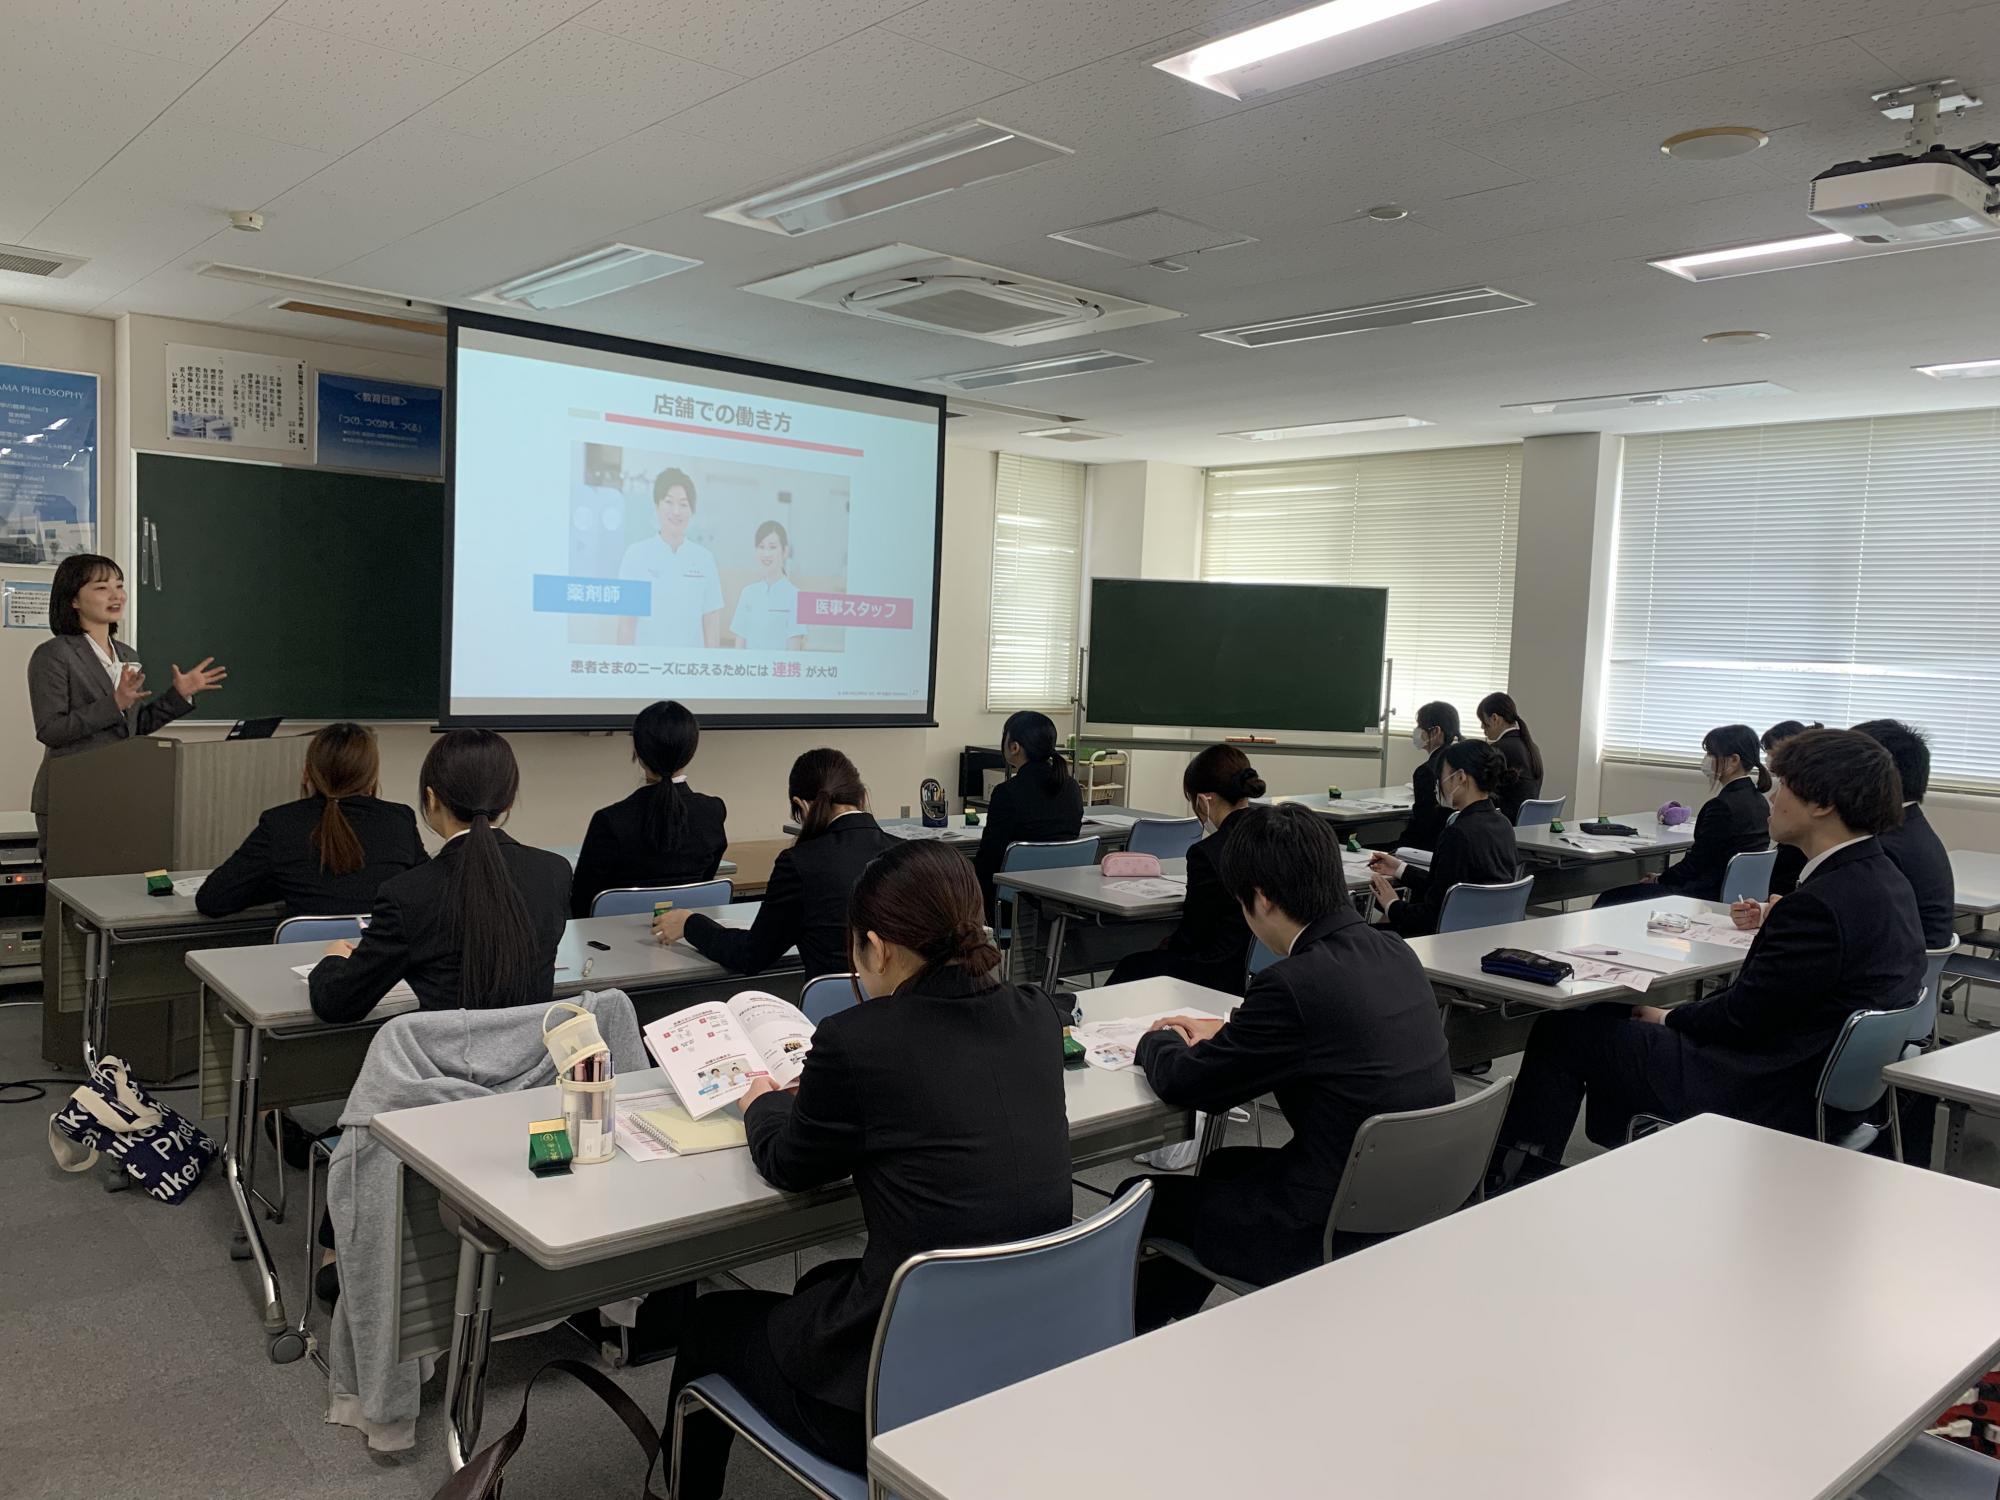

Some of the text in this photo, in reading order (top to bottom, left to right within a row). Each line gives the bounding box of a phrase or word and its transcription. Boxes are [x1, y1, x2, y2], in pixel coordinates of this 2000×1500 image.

[21, 385, 84, 400] PHILOSOPHY
[653, 393, 792, 433] 店舗での働き方
[567, 583, 621, 604] 薬剤師
[815, 599, 897, 618] 医事スタッフ
[571, 659, 838, 679] 患者さまのニーズに応えるためには 連携 が大切
